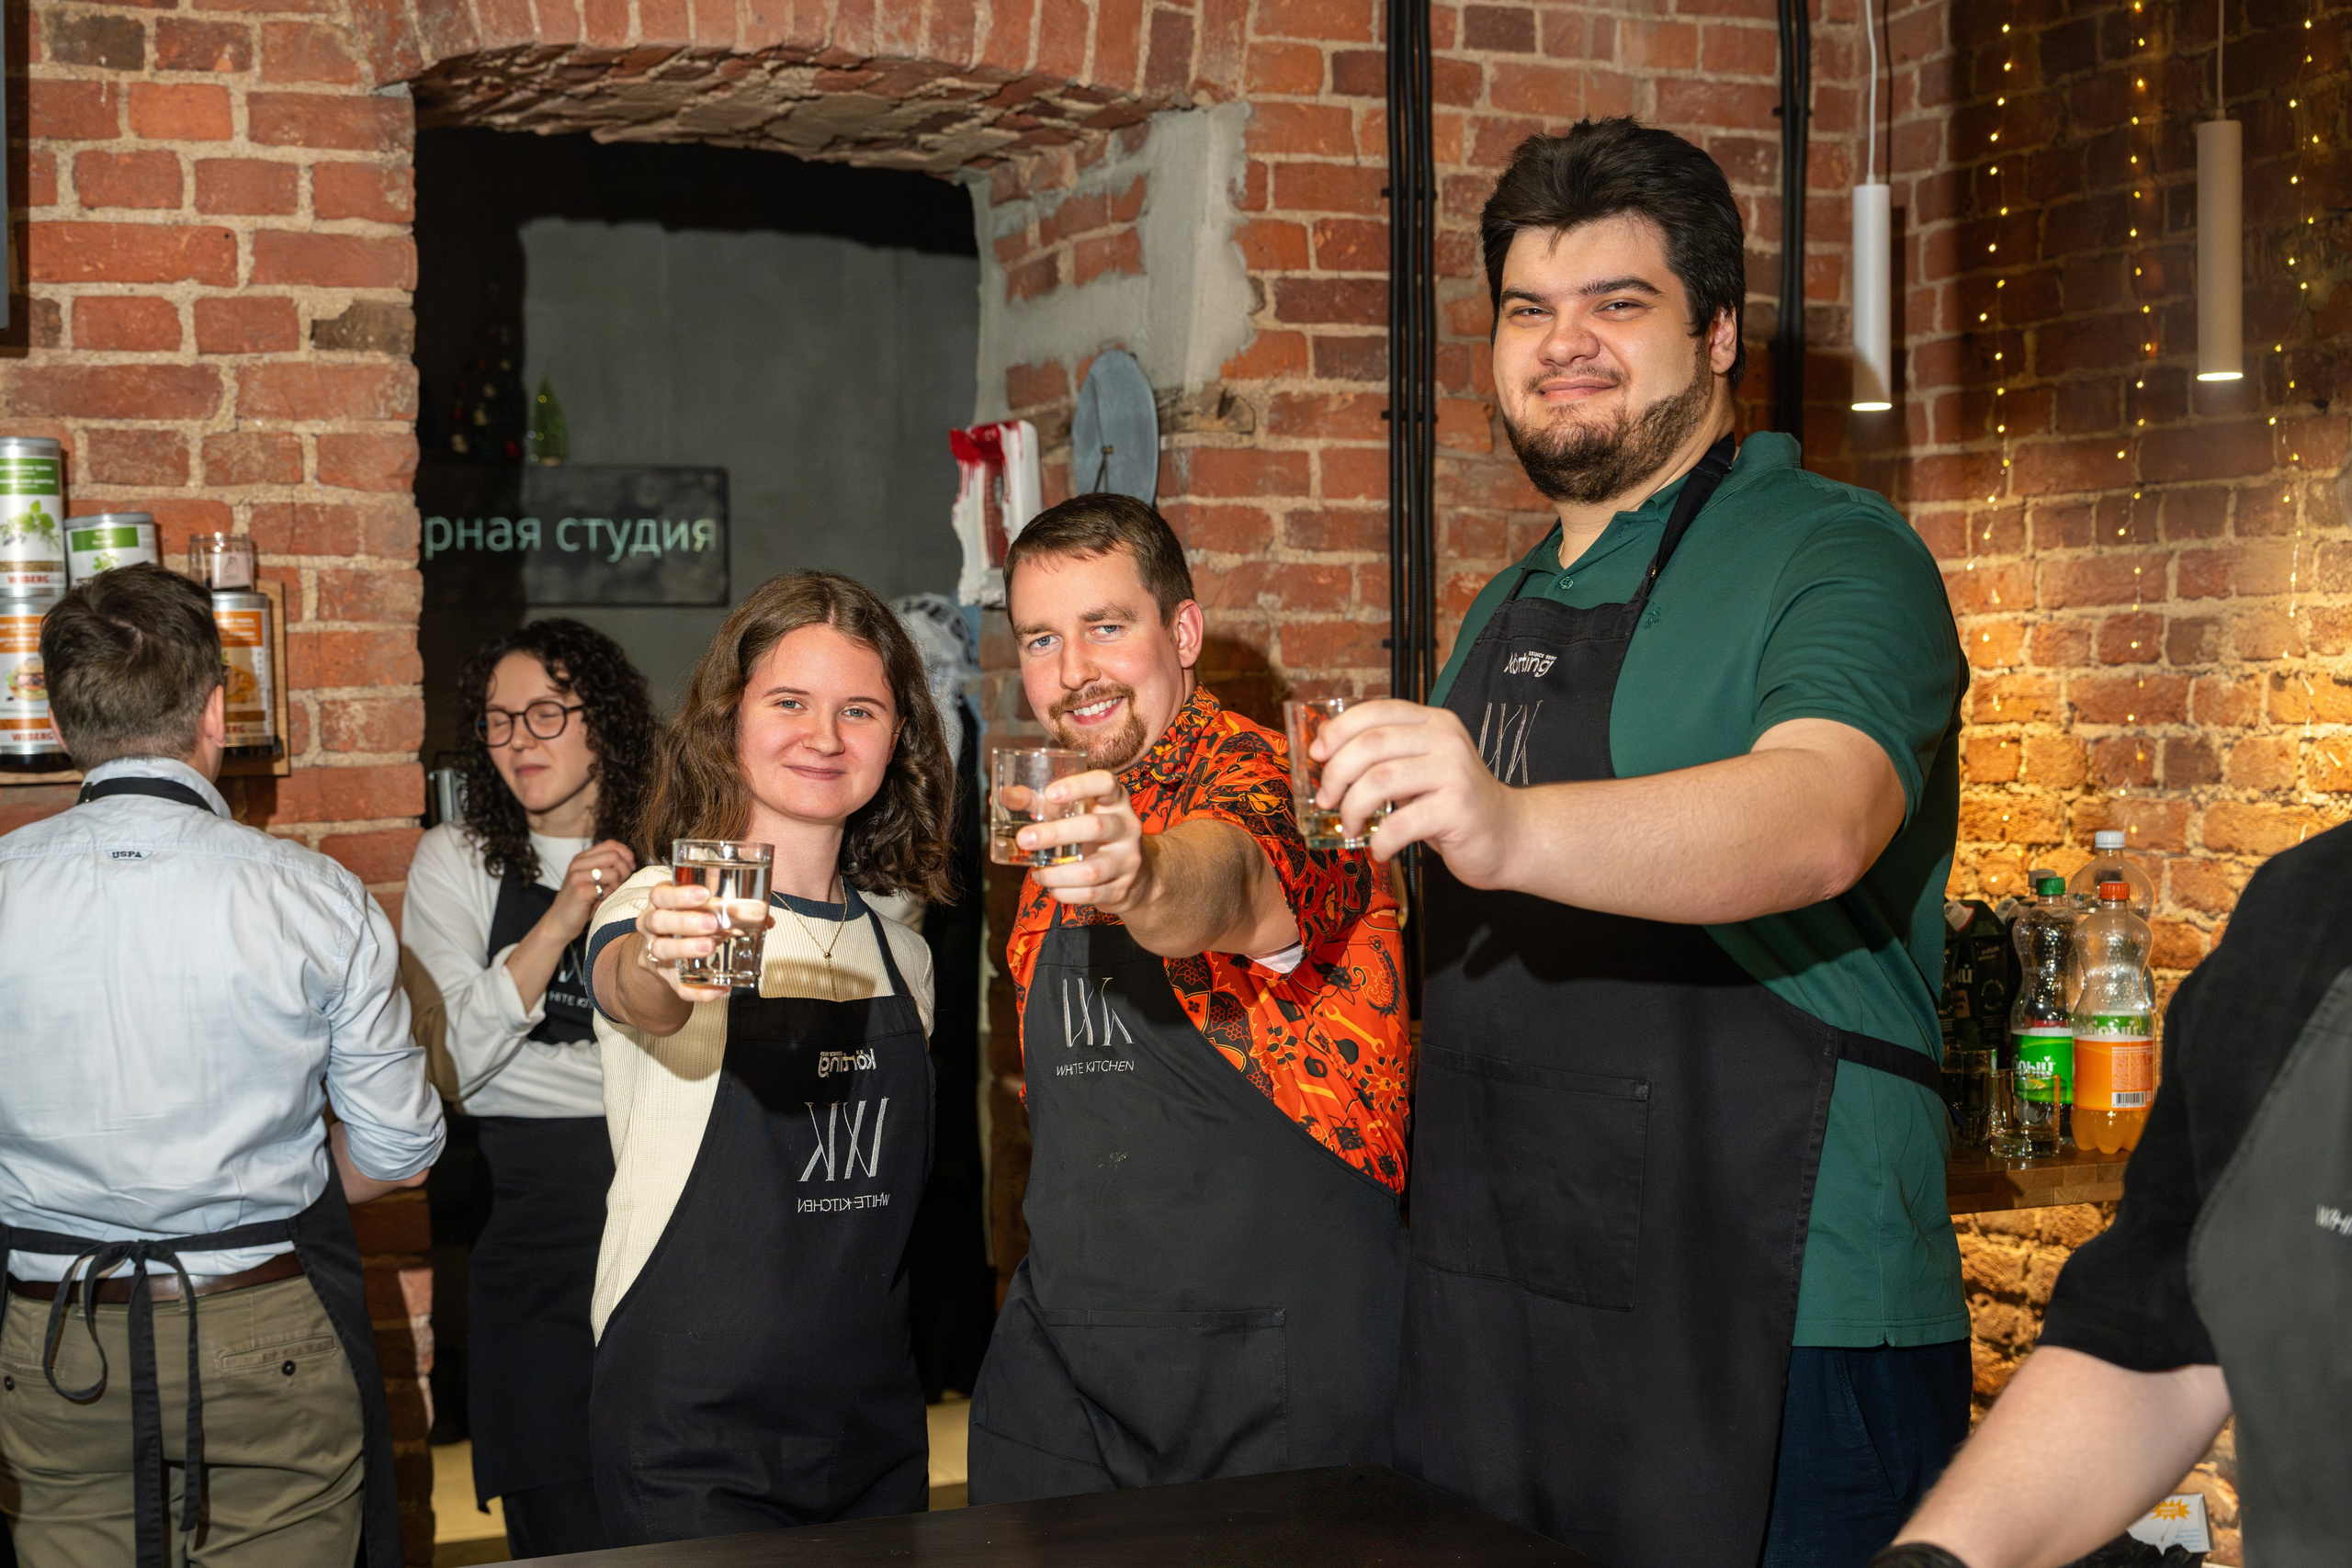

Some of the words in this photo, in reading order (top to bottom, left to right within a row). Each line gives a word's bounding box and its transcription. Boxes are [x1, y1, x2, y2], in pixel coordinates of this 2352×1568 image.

[424, 516, 541, 560] рная
[555, 517, 717, 562] студия
[7, 575, 50, 584] WBERG
[112, 851, 142, 859] USPA
[1056, 1062, 1084, 1077] WHITE
[1085, 1060, 1135, 1073] KITCHEN
